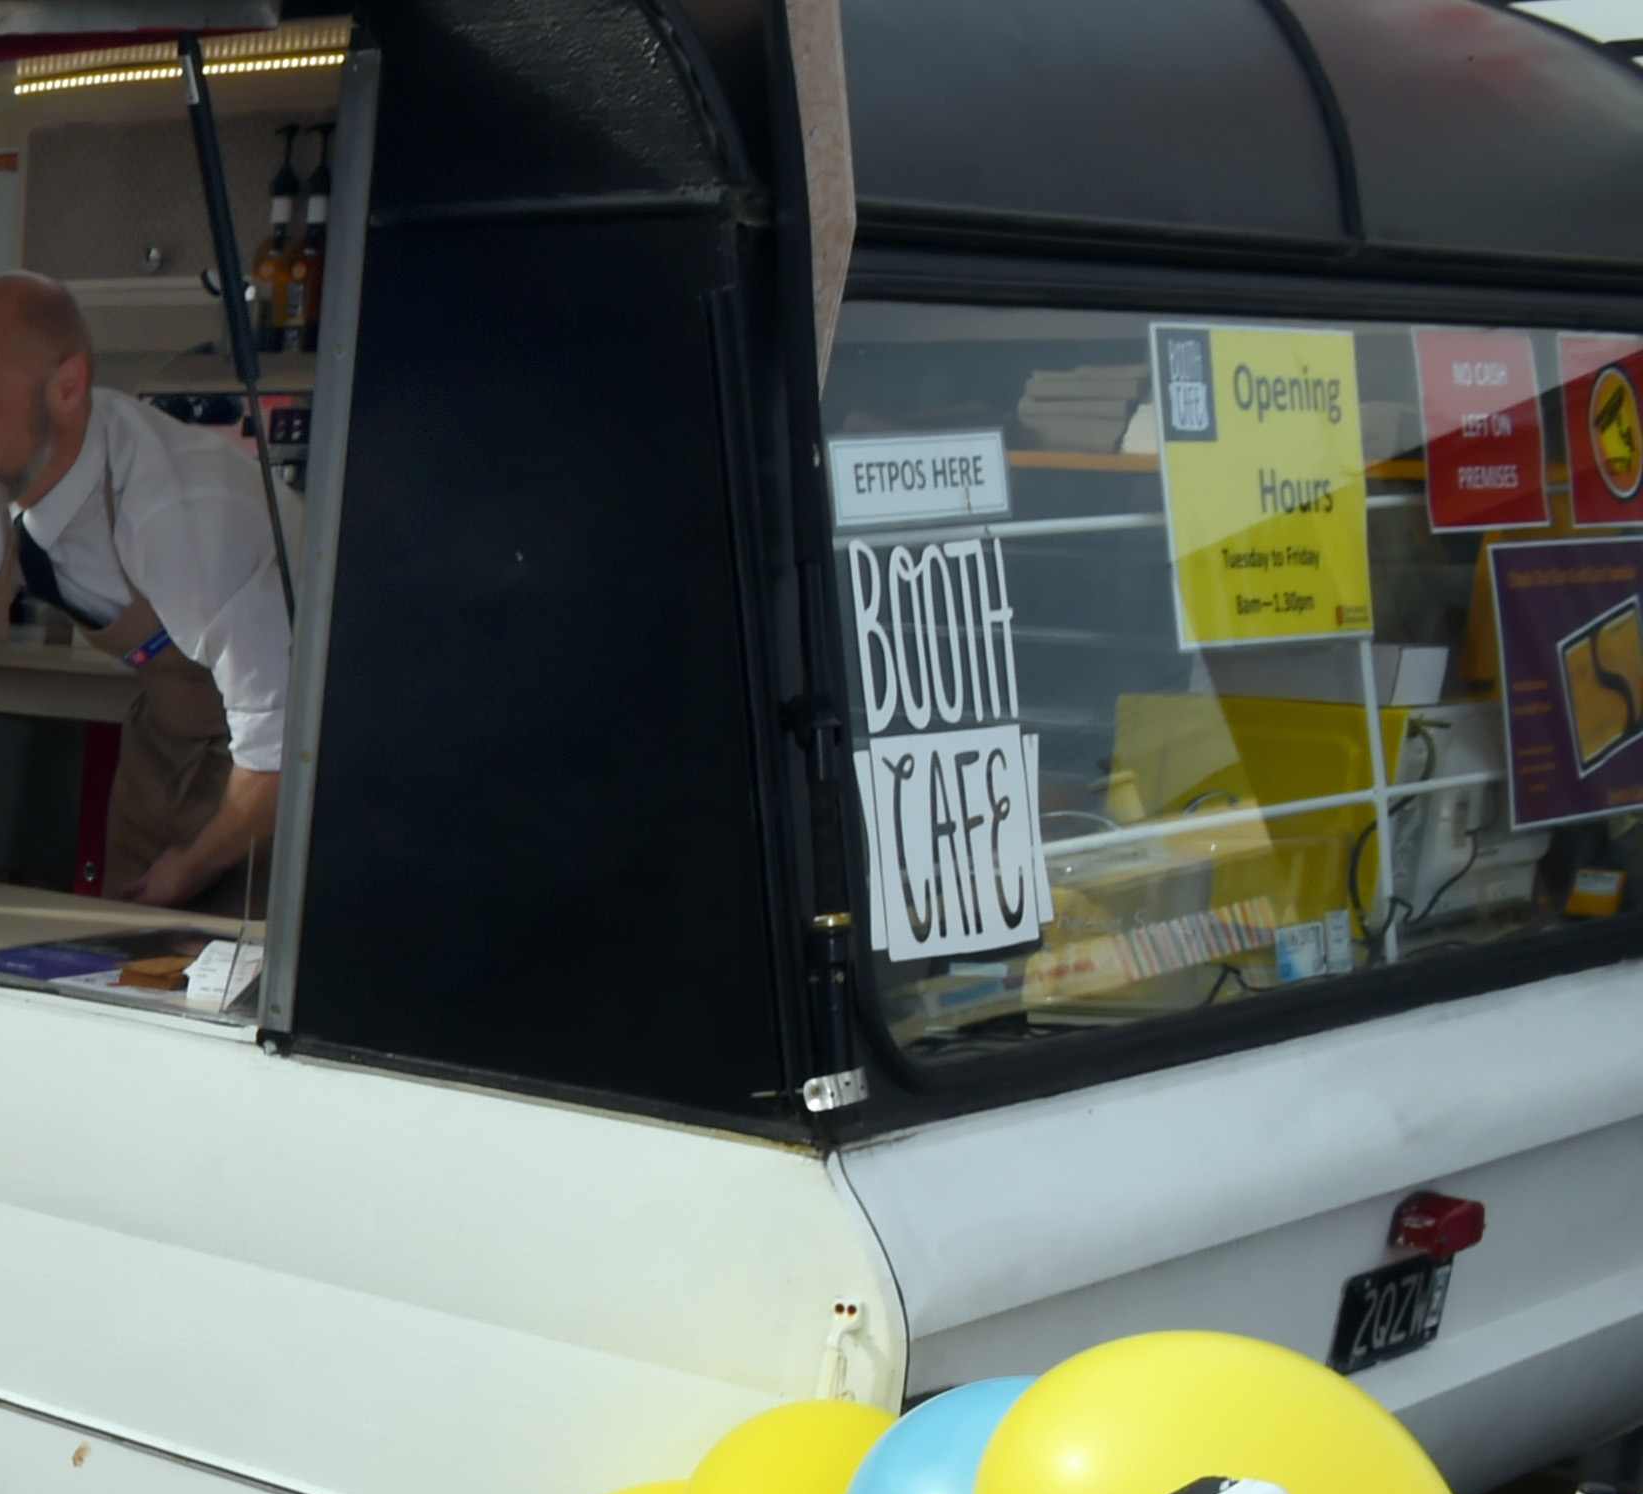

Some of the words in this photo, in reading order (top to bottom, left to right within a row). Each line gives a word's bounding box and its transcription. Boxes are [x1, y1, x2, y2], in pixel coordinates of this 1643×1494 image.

[1233, 364, 1343, 424] Opening
[1453, 362, 1472, 386] NO
[1475, 361, 1508, 386] CASH
[1461, 412, 1490, 438] LEFT
[1492, 411, 1512, 437] ON
[853, 460, 927, 495] EFTPOS
[931, 453, 985, 489] HERE
[1458, 465, 1519, 490] PREMISES
[1259, 468, 1334, 524] Hours
[1221, 548, 1270, 572] Tuesday
[1271, 550, 1284, 568] to
[1286, 548, 1321, 569] Friday
[848, 537, 1019, 734] BOOTH
[881, 746, 1026, 944] CAFE
